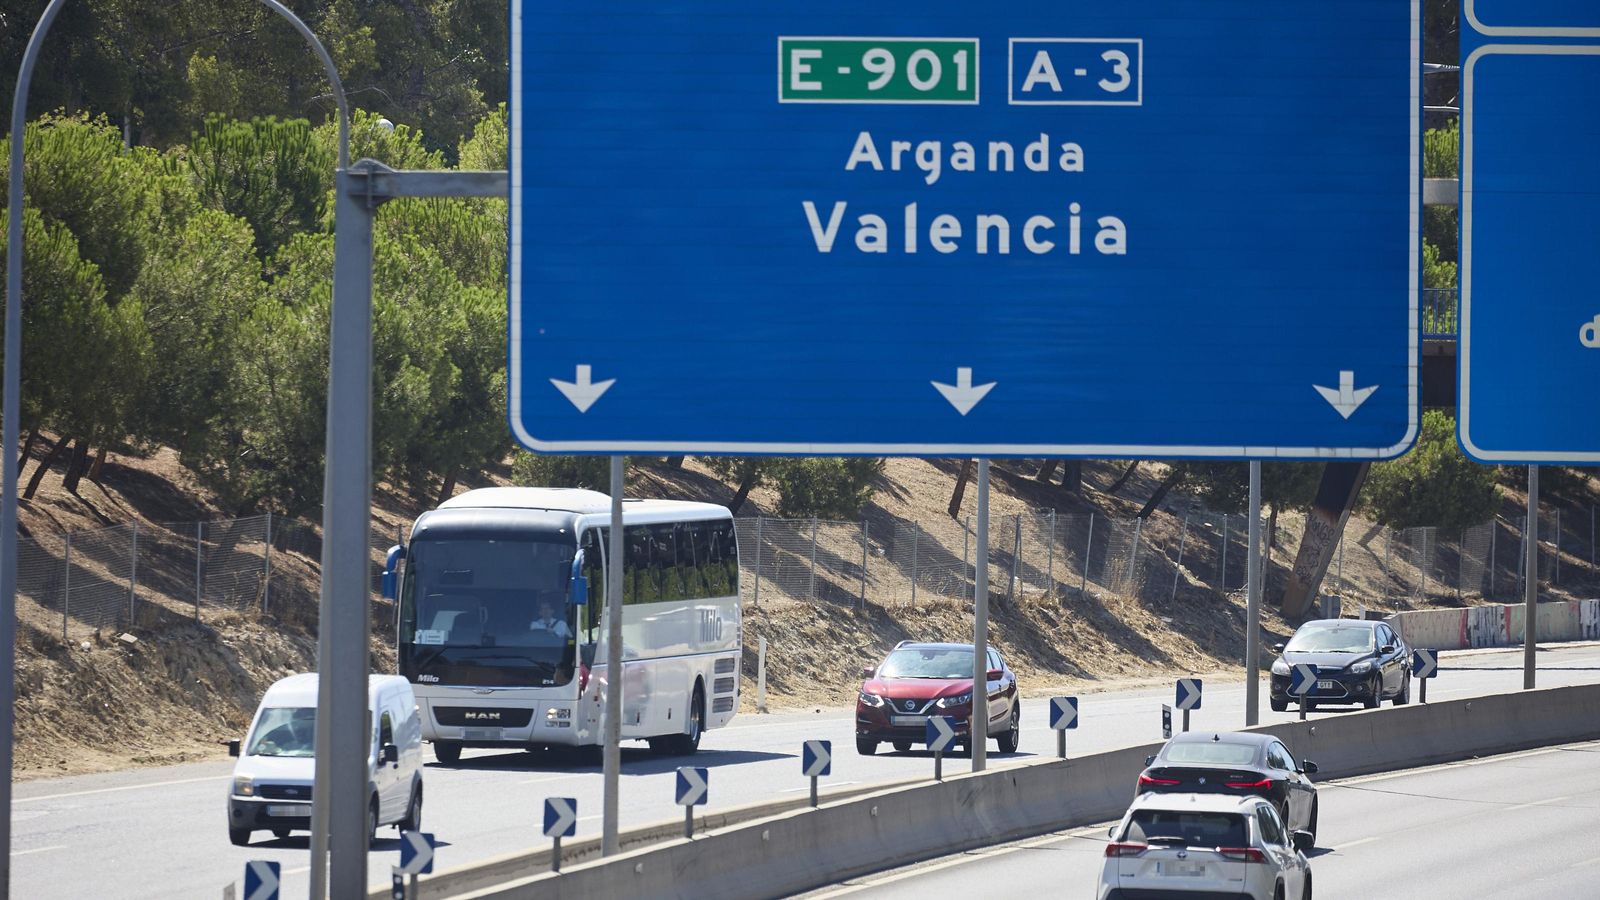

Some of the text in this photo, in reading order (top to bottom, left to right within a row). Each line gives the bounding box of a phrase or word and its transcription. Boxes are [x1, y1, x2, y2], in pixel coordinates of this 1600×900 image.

[790, 48, 968, 91] E-901
[1021, 49, 1131, 93] A-3
[845, 131, 1085, 185] Arganda
[802, 201, 1128, 255] Valencia
[417, 674, 440, 683] Milo
[465, 712, 501, 720] MAN
